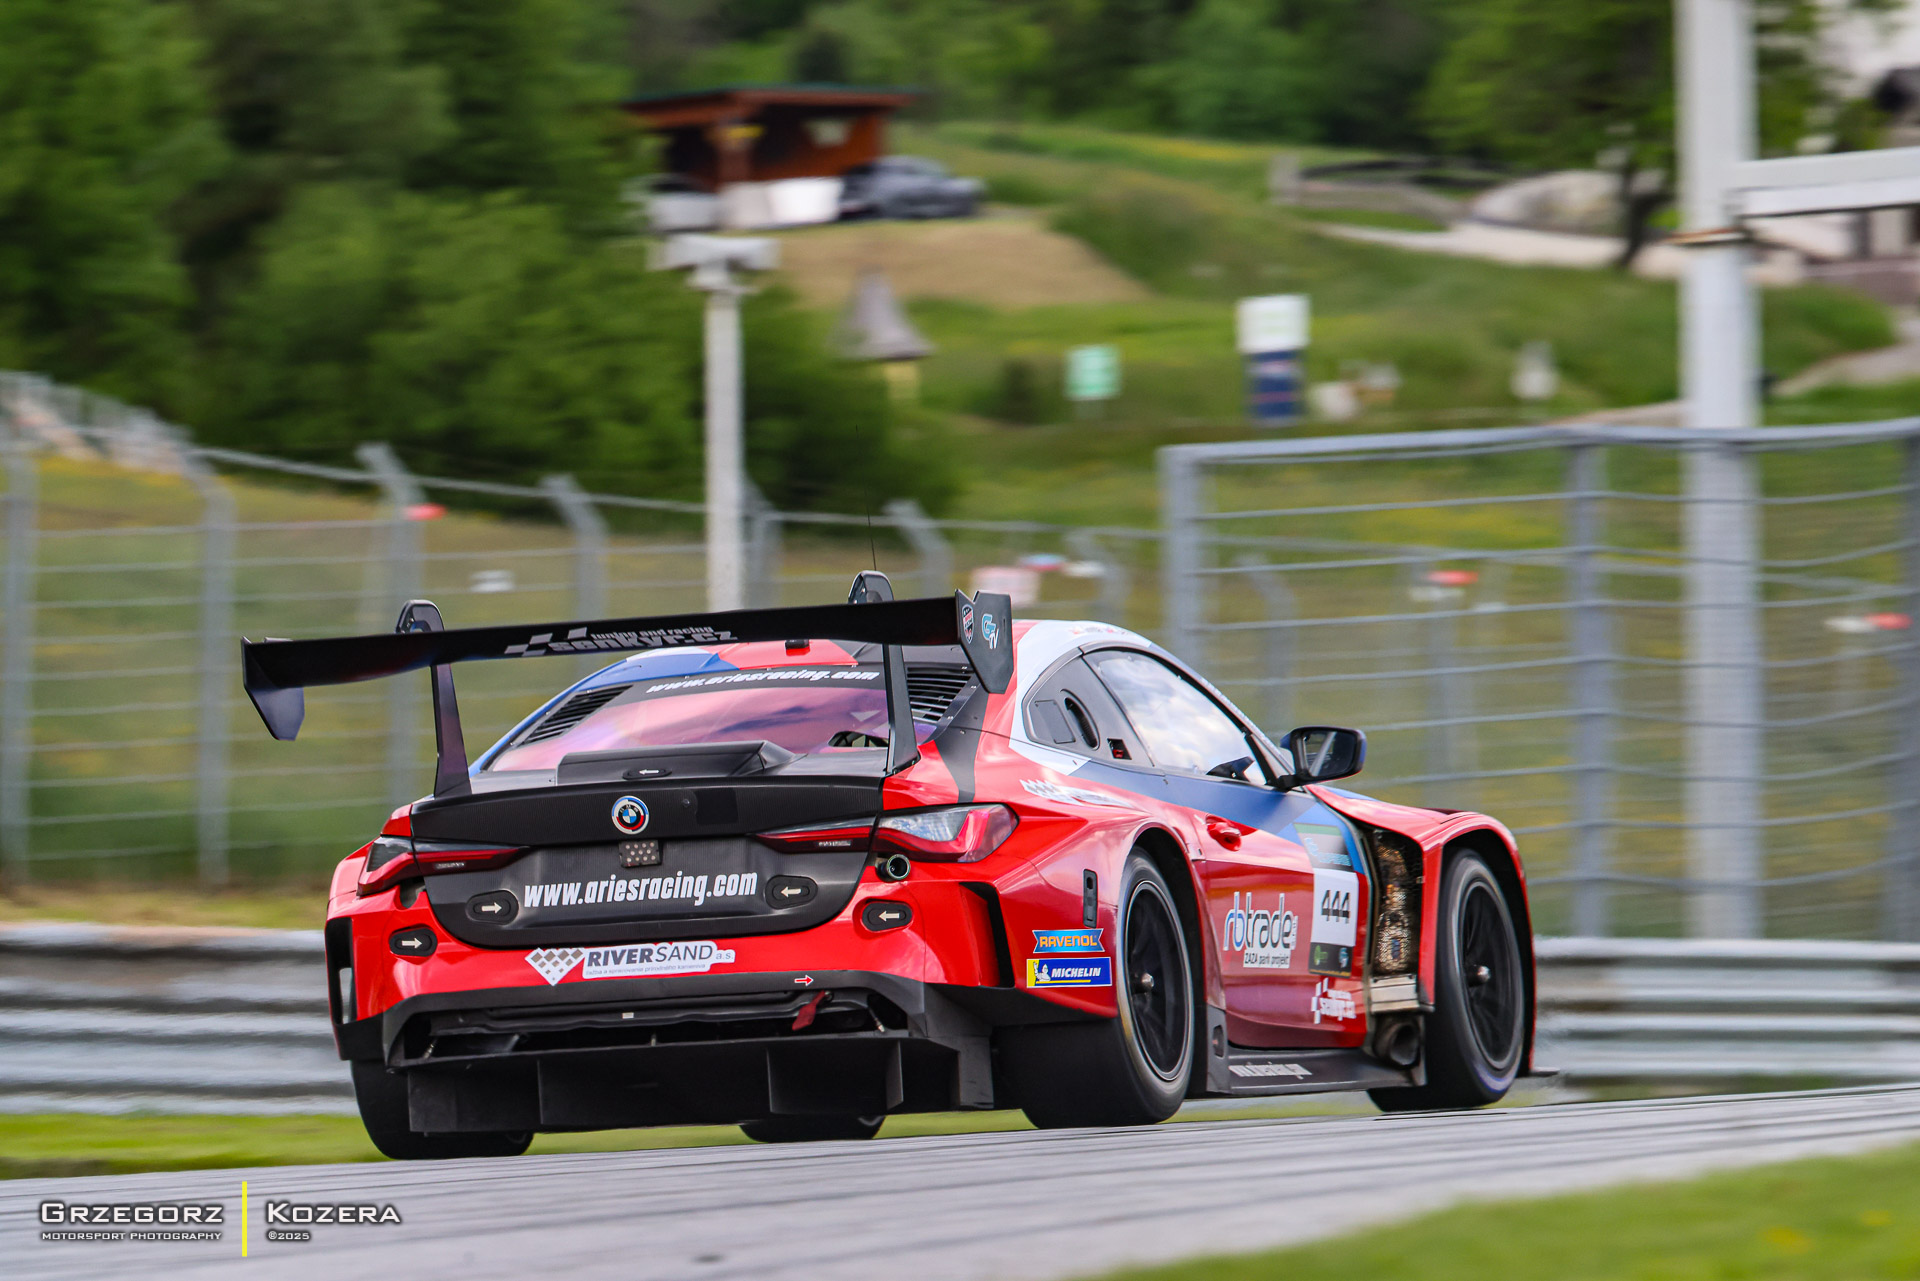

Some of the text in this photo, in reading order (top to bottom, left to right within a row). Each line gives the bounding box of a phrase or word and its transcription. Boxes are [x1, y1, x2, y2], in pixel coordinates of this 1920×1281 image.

[548, 631, 738, 651] senkyr.cz
[639, 628, 667, 638] and
[667, 625, 714, 637] racing
[646, 669, 880, 693] www.ariesracing.com
[524, 871, 758, 908] www.ariesracing.com
[1320, 889, 1350, 925] 444
[1223, 891, 1293, 951] rbtrade
[1039, 934, 1098, 948] RAVENOL
[587, 945, 713, 967] RIVERSAND
[1051, 967, 1102, 978] MICHELIN
